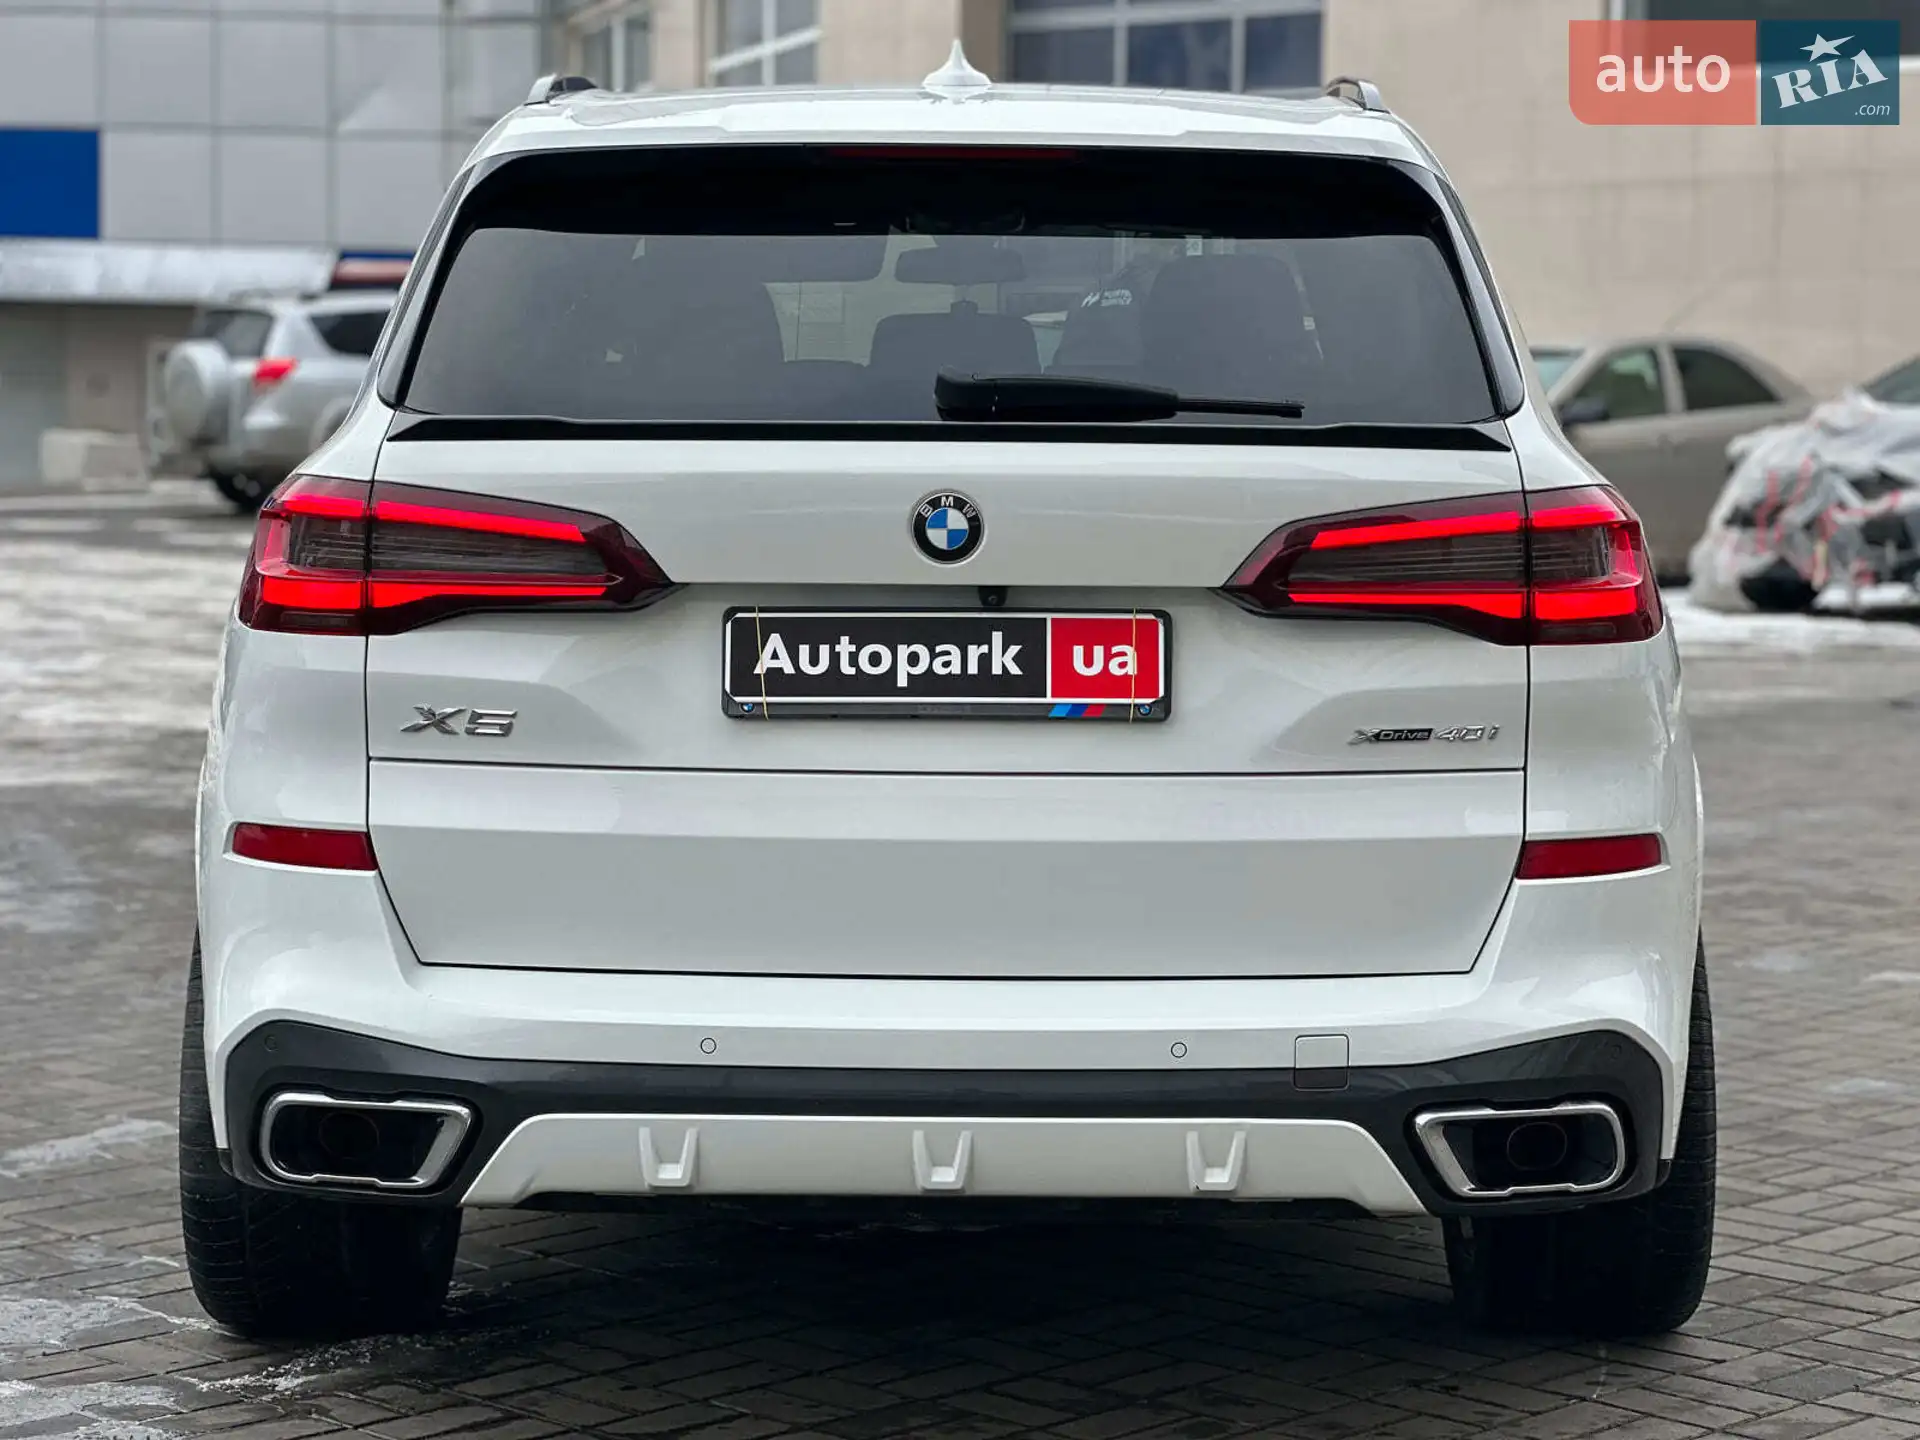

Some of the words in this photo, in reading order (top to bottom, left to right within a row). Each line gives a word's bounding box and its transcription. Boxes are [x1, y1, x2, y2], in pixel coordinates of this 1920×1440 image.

[919, 495, 977, 518] BMW
[753, 630, 1024, 688] Autopark
[1071, 643, 1138, 677] ua
[400, 702, 518, 738] X5
